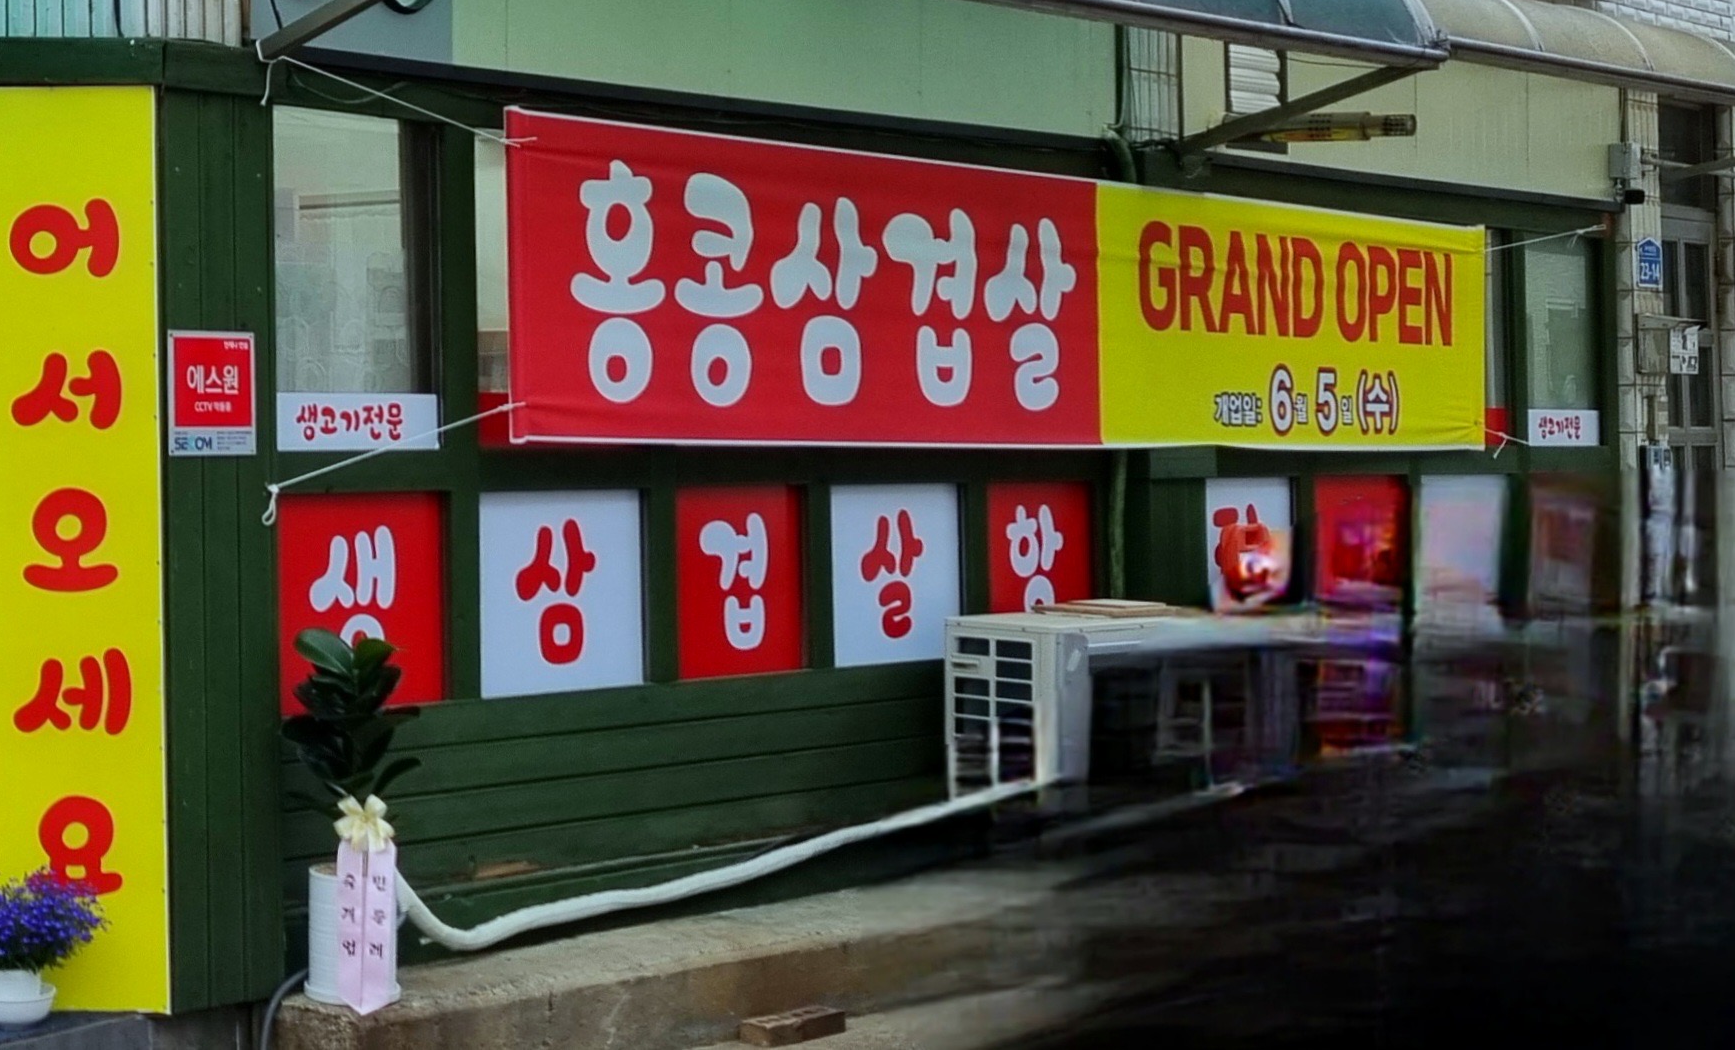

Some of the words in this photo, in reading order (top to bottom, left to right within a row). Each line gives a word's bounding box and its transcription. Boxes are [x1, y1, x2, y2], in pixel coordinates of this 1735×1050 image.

[569, 158, 1077, 413] 홍콩삼겹살
[1137, 219, 1324, 339] GRAND
[1335, 239, 1455, 348] OPEN
[1640, 262, 1660, 281] 23-14
[186, 364, 240, 396] 에스원
[1356, 368, 1400, 435] (수)
[295, 400, 404, 442] 생고기전문
[1538, 415, 1581, 440] 생고기전문
[9, 197, 134, 896] 어서오세요
[515, 518, 596, 666] 삼
[699, 511, 768, 650] 겹
[860, 508, 925, 640] 살
